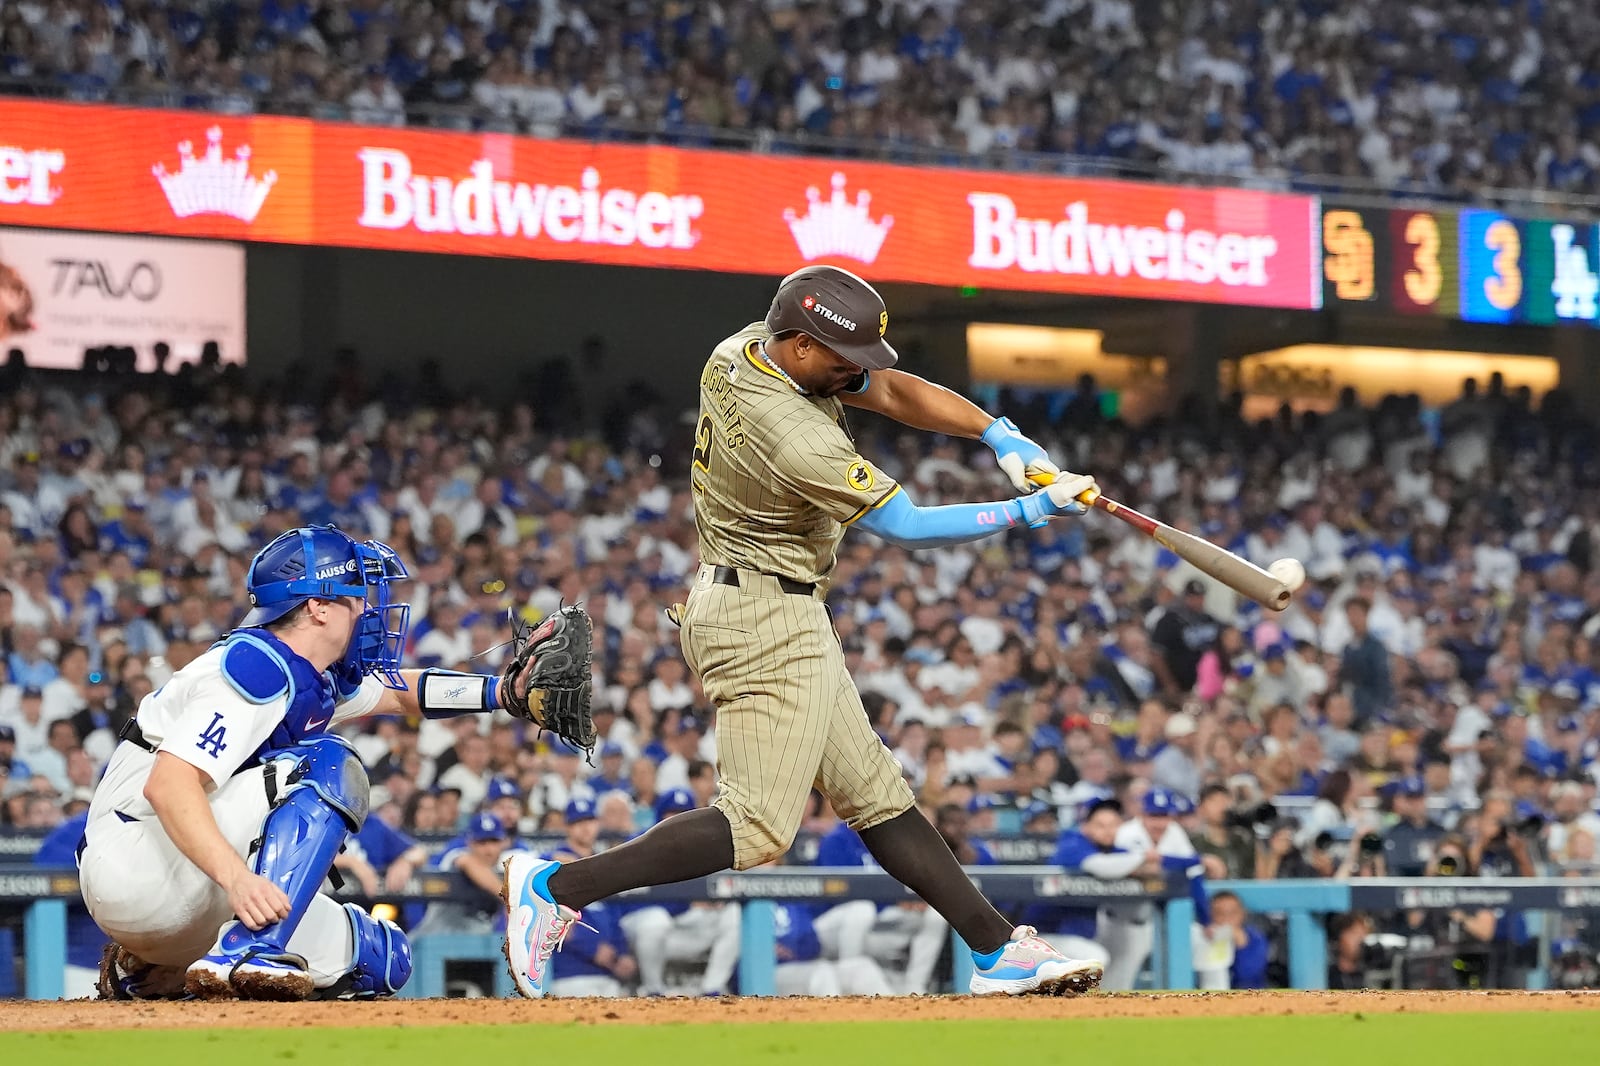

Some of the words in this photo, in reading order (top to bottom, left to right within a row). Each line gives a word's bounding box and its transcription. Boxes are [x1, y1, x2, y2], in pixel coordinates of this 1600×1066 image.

[0, 146, 65, 206] er
[358, 147, 704, 249] Budweiser
[967, 191, 1278, 286] Budweiser
[1404, 213, 1442, 306] 3
[1484, 220, 1522, 309] 3
[1551, 224, 1599, 319] LA
[813, 303, 857, 332] STRAUSS
[976, 510, 997, 525] 2
[196, 711, 227, 759] LA
